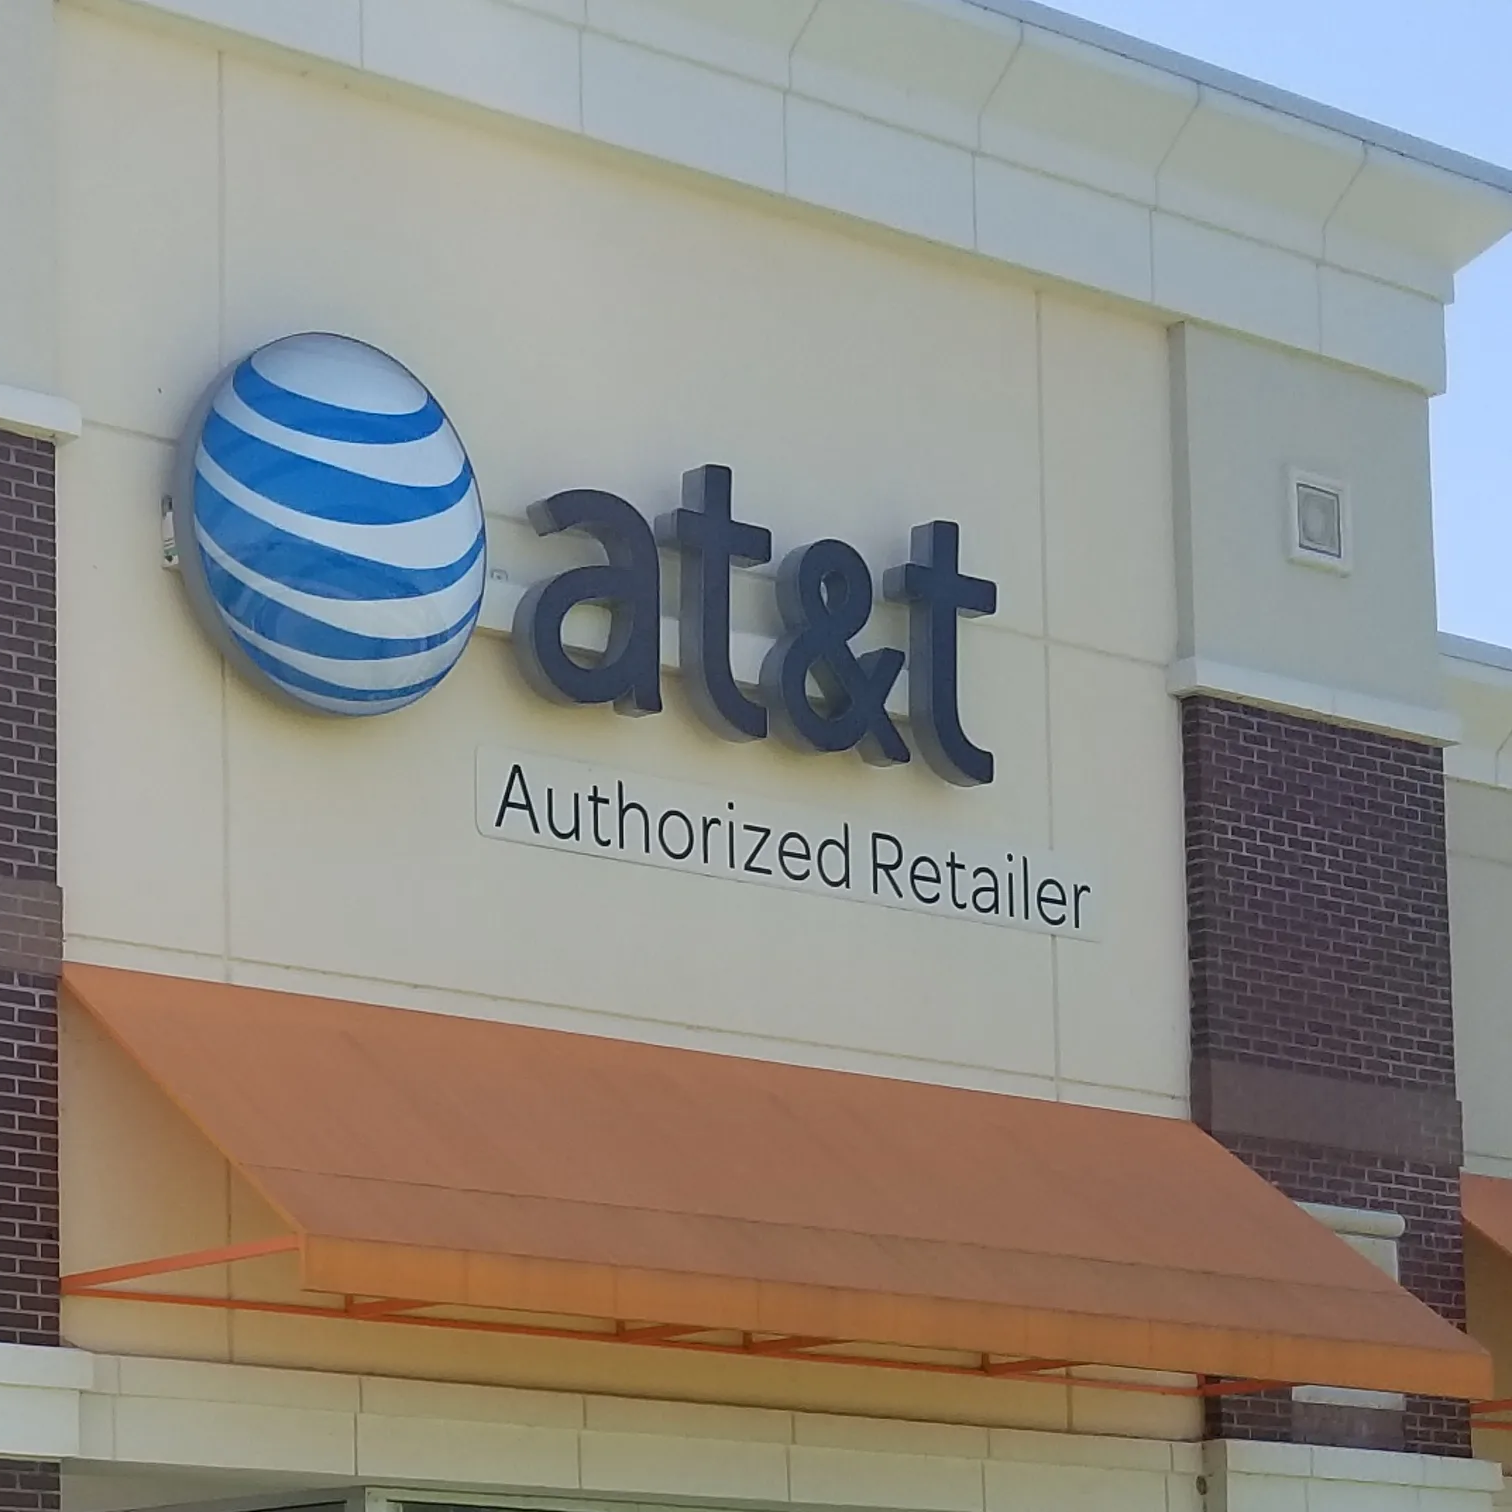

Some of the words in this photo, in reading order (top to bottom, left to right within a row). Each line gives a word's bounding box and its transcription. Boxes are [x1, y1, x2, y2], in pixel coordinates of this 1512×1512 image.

[512, 464, 997, 787] at&t
[495, 764, 851, 890] Authorized
[870, 832, 1091, 929] Retailer
